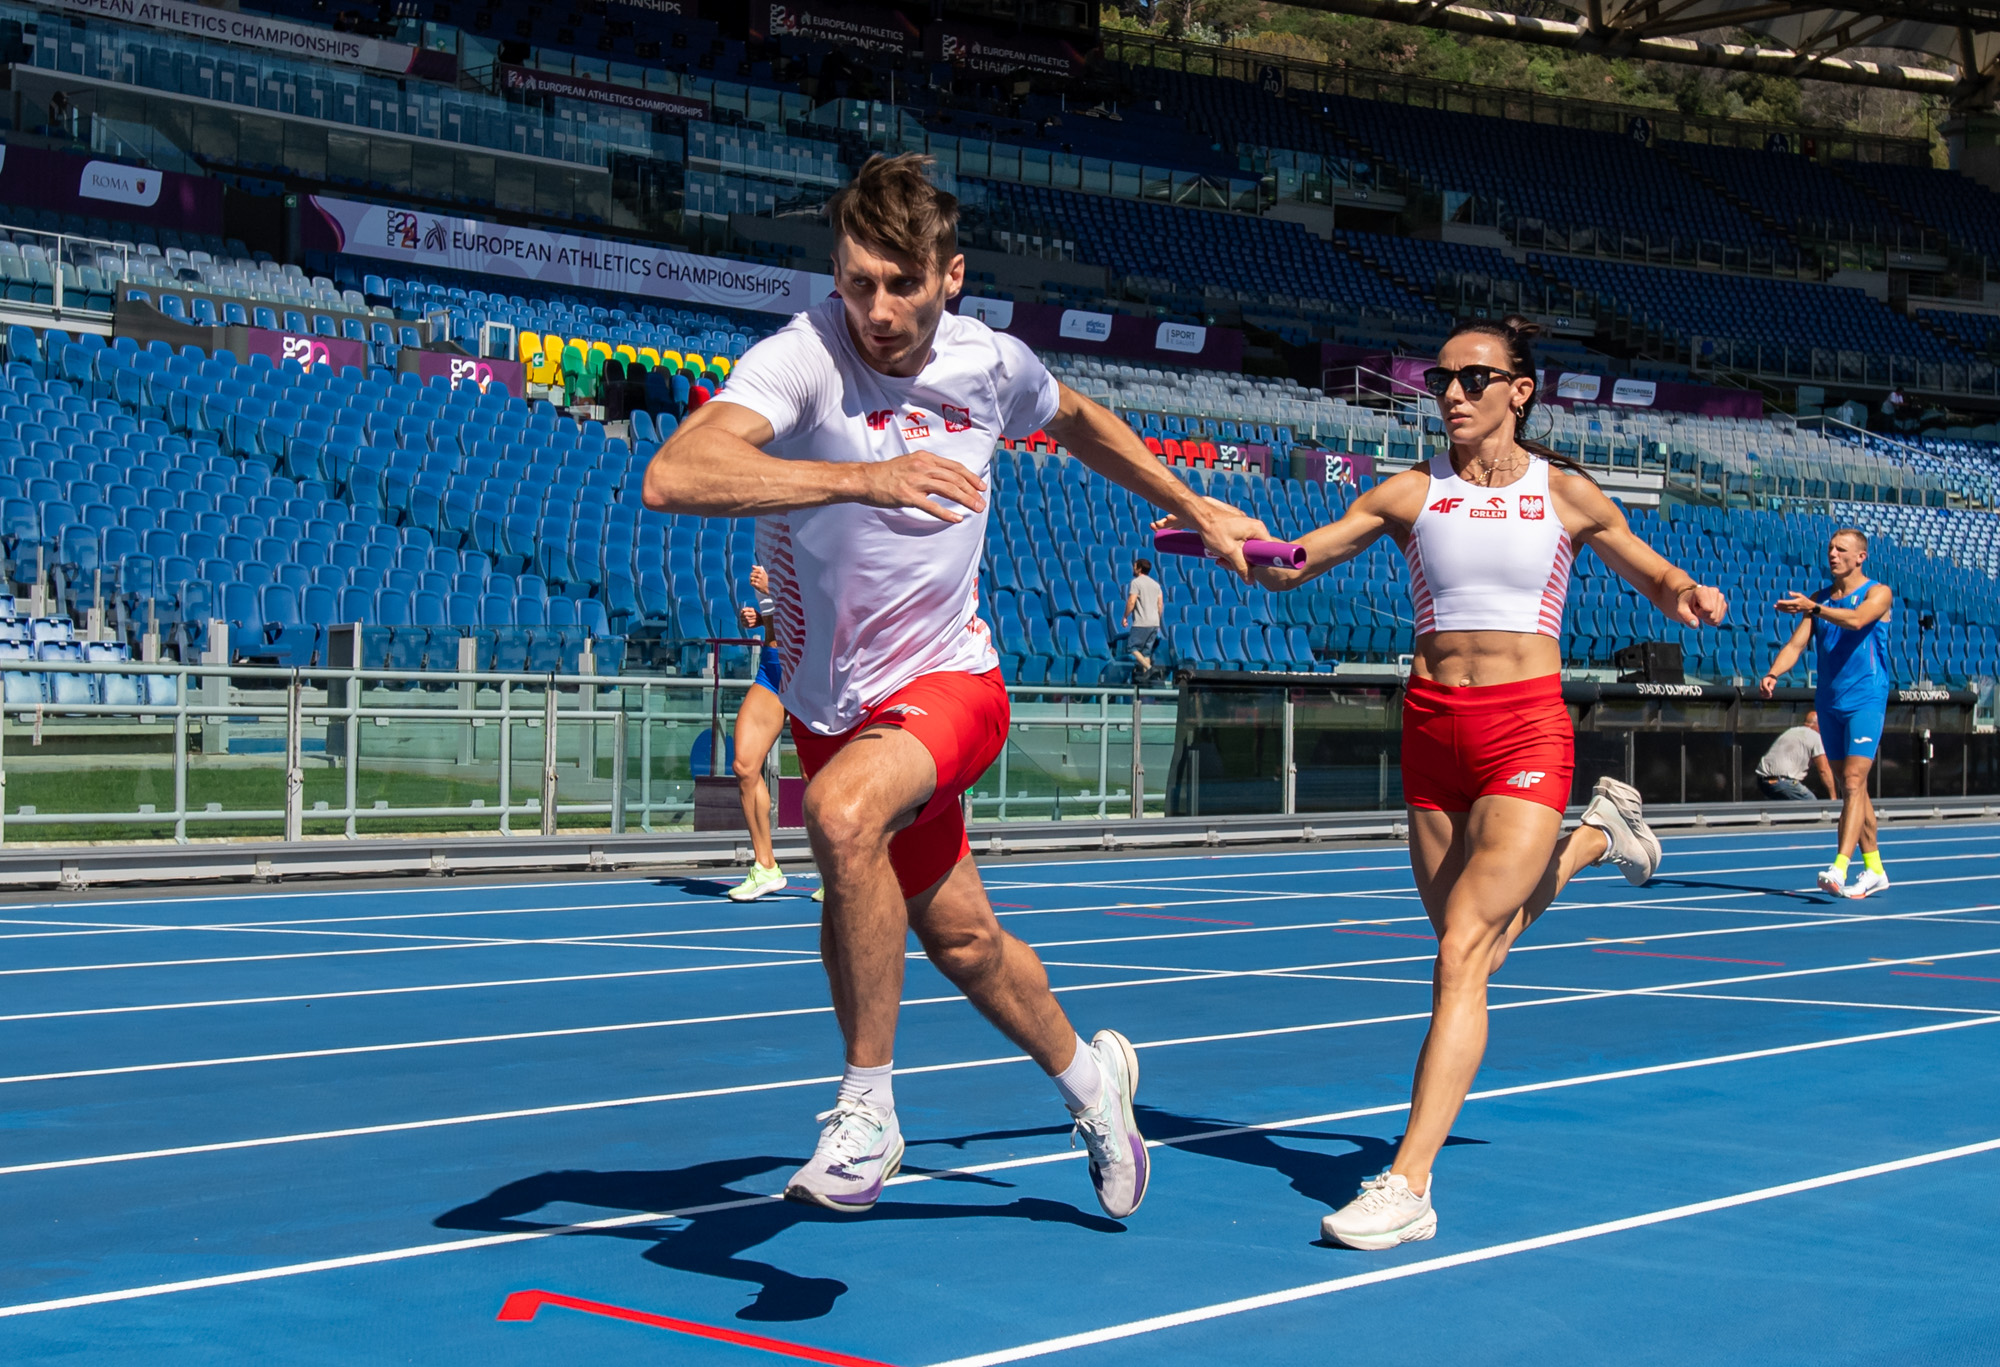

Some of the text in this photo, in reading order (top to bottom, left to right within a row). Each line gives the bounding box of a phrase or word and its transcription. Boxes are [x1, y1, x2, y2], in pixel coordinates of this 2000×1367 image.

[138, 3, 227, 34] ATHLETICS
[231, 21, 360, 58] CHAMPIONSHIPS
[812, 15, 904, 41] EUROPEAN ATHLETICS
[983, 46, 1026, 61] EUROPEAN
[1027, 54, 1070, 69] ATHLETICS
[538, 79, 586, 97] EUROPEAN
[587, 89, 634, 106] ATHLETICS
[635, 98, 703, 118] CHAMPIONSHIPS
[92, 174, 129, 192] ROMA
[453, 231, 791, 297] EUROPEAN ATHLETICS CHAMPIONSHIPS
[1171, 329, 1196, 340] SPORT
[866, 409, 895, 431] 4F
[903, 427, 928, 439] RLEN
[1429, 498, 1465, 513] 4F
[1471, 510, 1505, 518] ORLEN
[1635, 683, 1703, 697] STADIO OLIMPICO
[1898, 690, 1950, 702] STADIO OLIMPICO
[1506, 770, 1546, 788] 4F
